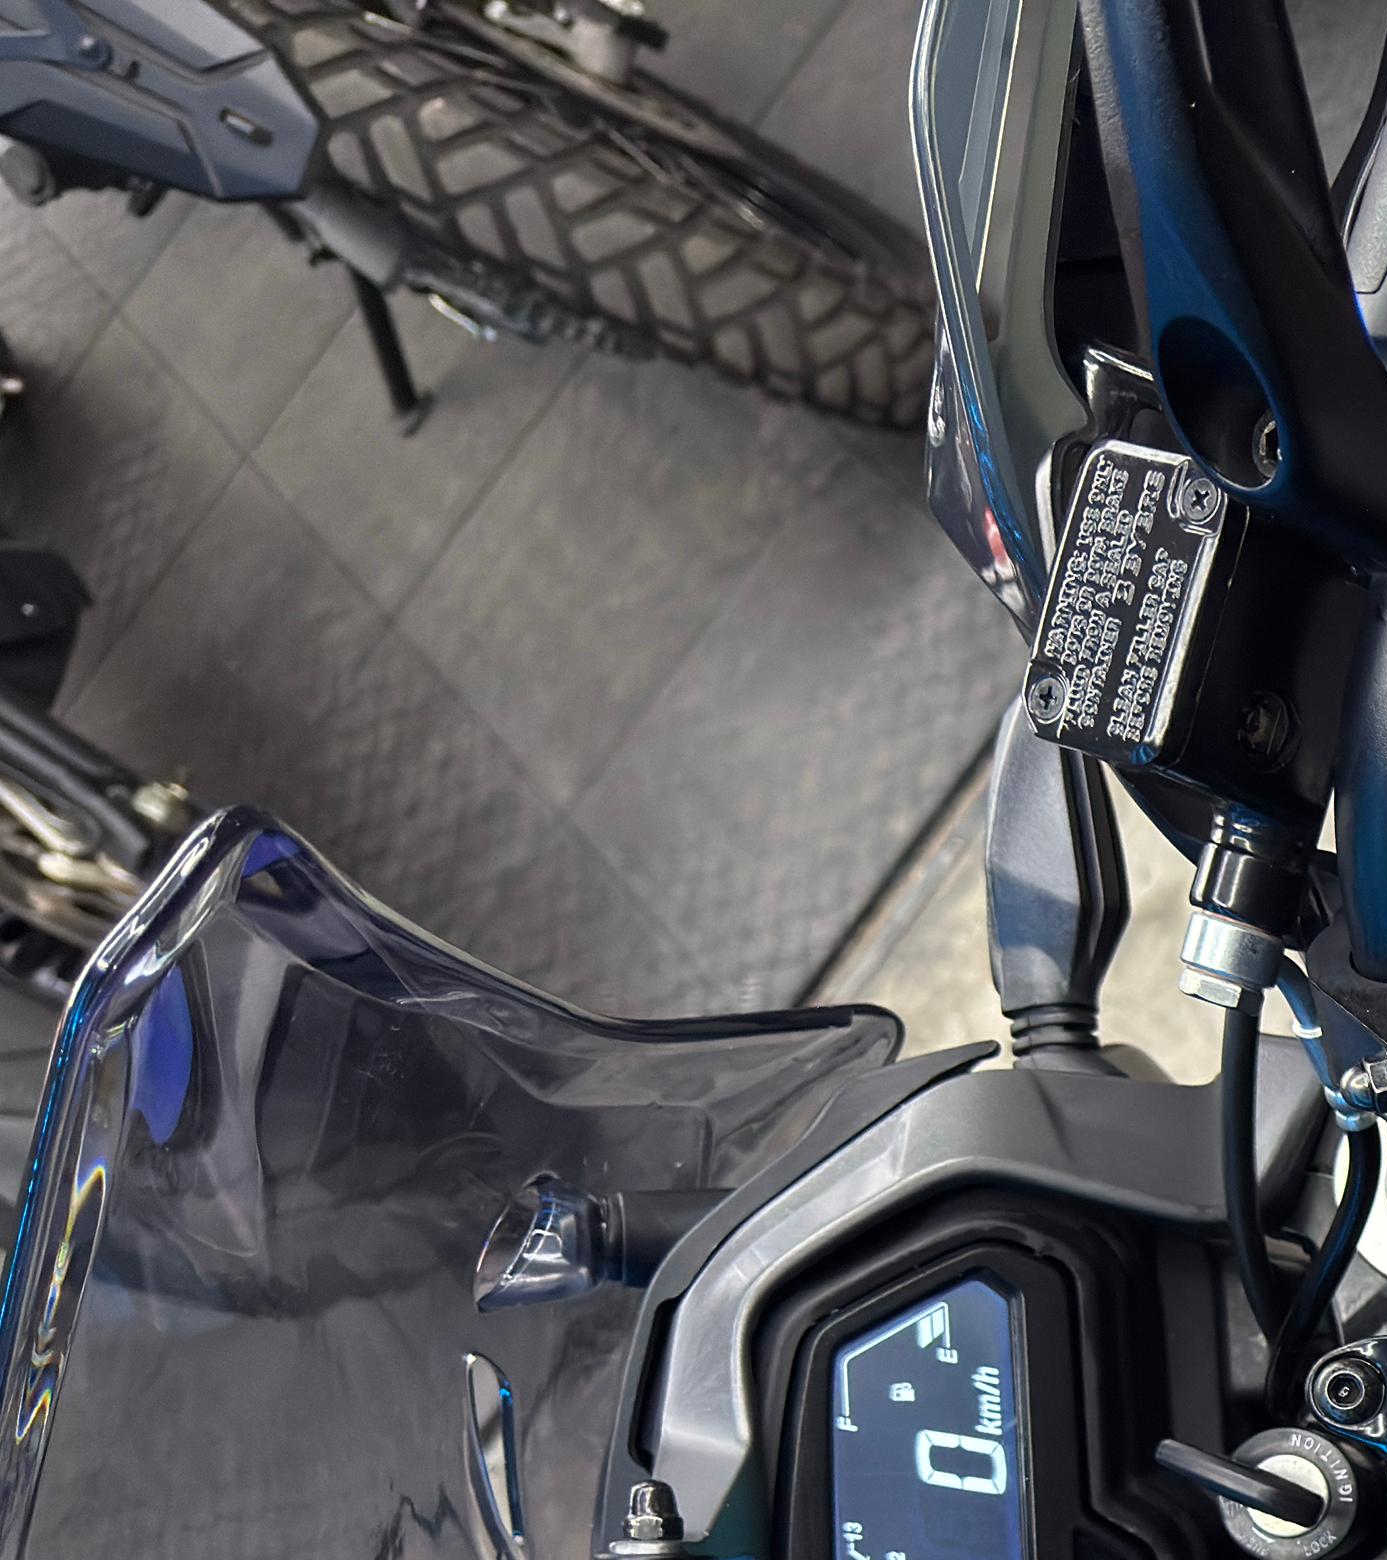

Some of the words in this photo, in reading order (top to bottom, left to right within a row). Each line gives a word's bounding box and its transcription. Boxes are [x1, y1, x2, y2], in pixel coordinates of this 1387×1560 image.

[1088, 455, 1114, 505] ONLY
[1099, 468, 1128, 534] BRAKE
[1077, 507, 1100, 547] USE
[1100, 509, 1133, 588] SEALED
[1094, 588, 1111, 607] A
[1079, 609, 1105, 662] FROM
[1107, 669, 1138, 738] CLEAN
[1128, 592, 1158, 666] FILLER
[1148, 547, 1171, 590] CAP
[1124, 665, 1157, 743] BEFORE
[1146, 558, 1187, 663] REMOVING
[1062, 663, 1090, 724] FLUID
[1079, 617, 1121, 731] CONTAINER
[936, 1348, 959, 1364] E
[835, 1416, 858, 1432] F
[972, 1366, 1002, 1435] km/h
[1289, 1434, 1353, 1502] IGNITION
[842, 1521, 863, 1541] 13
[1303, 1530, 1337, 1557] LOCK
